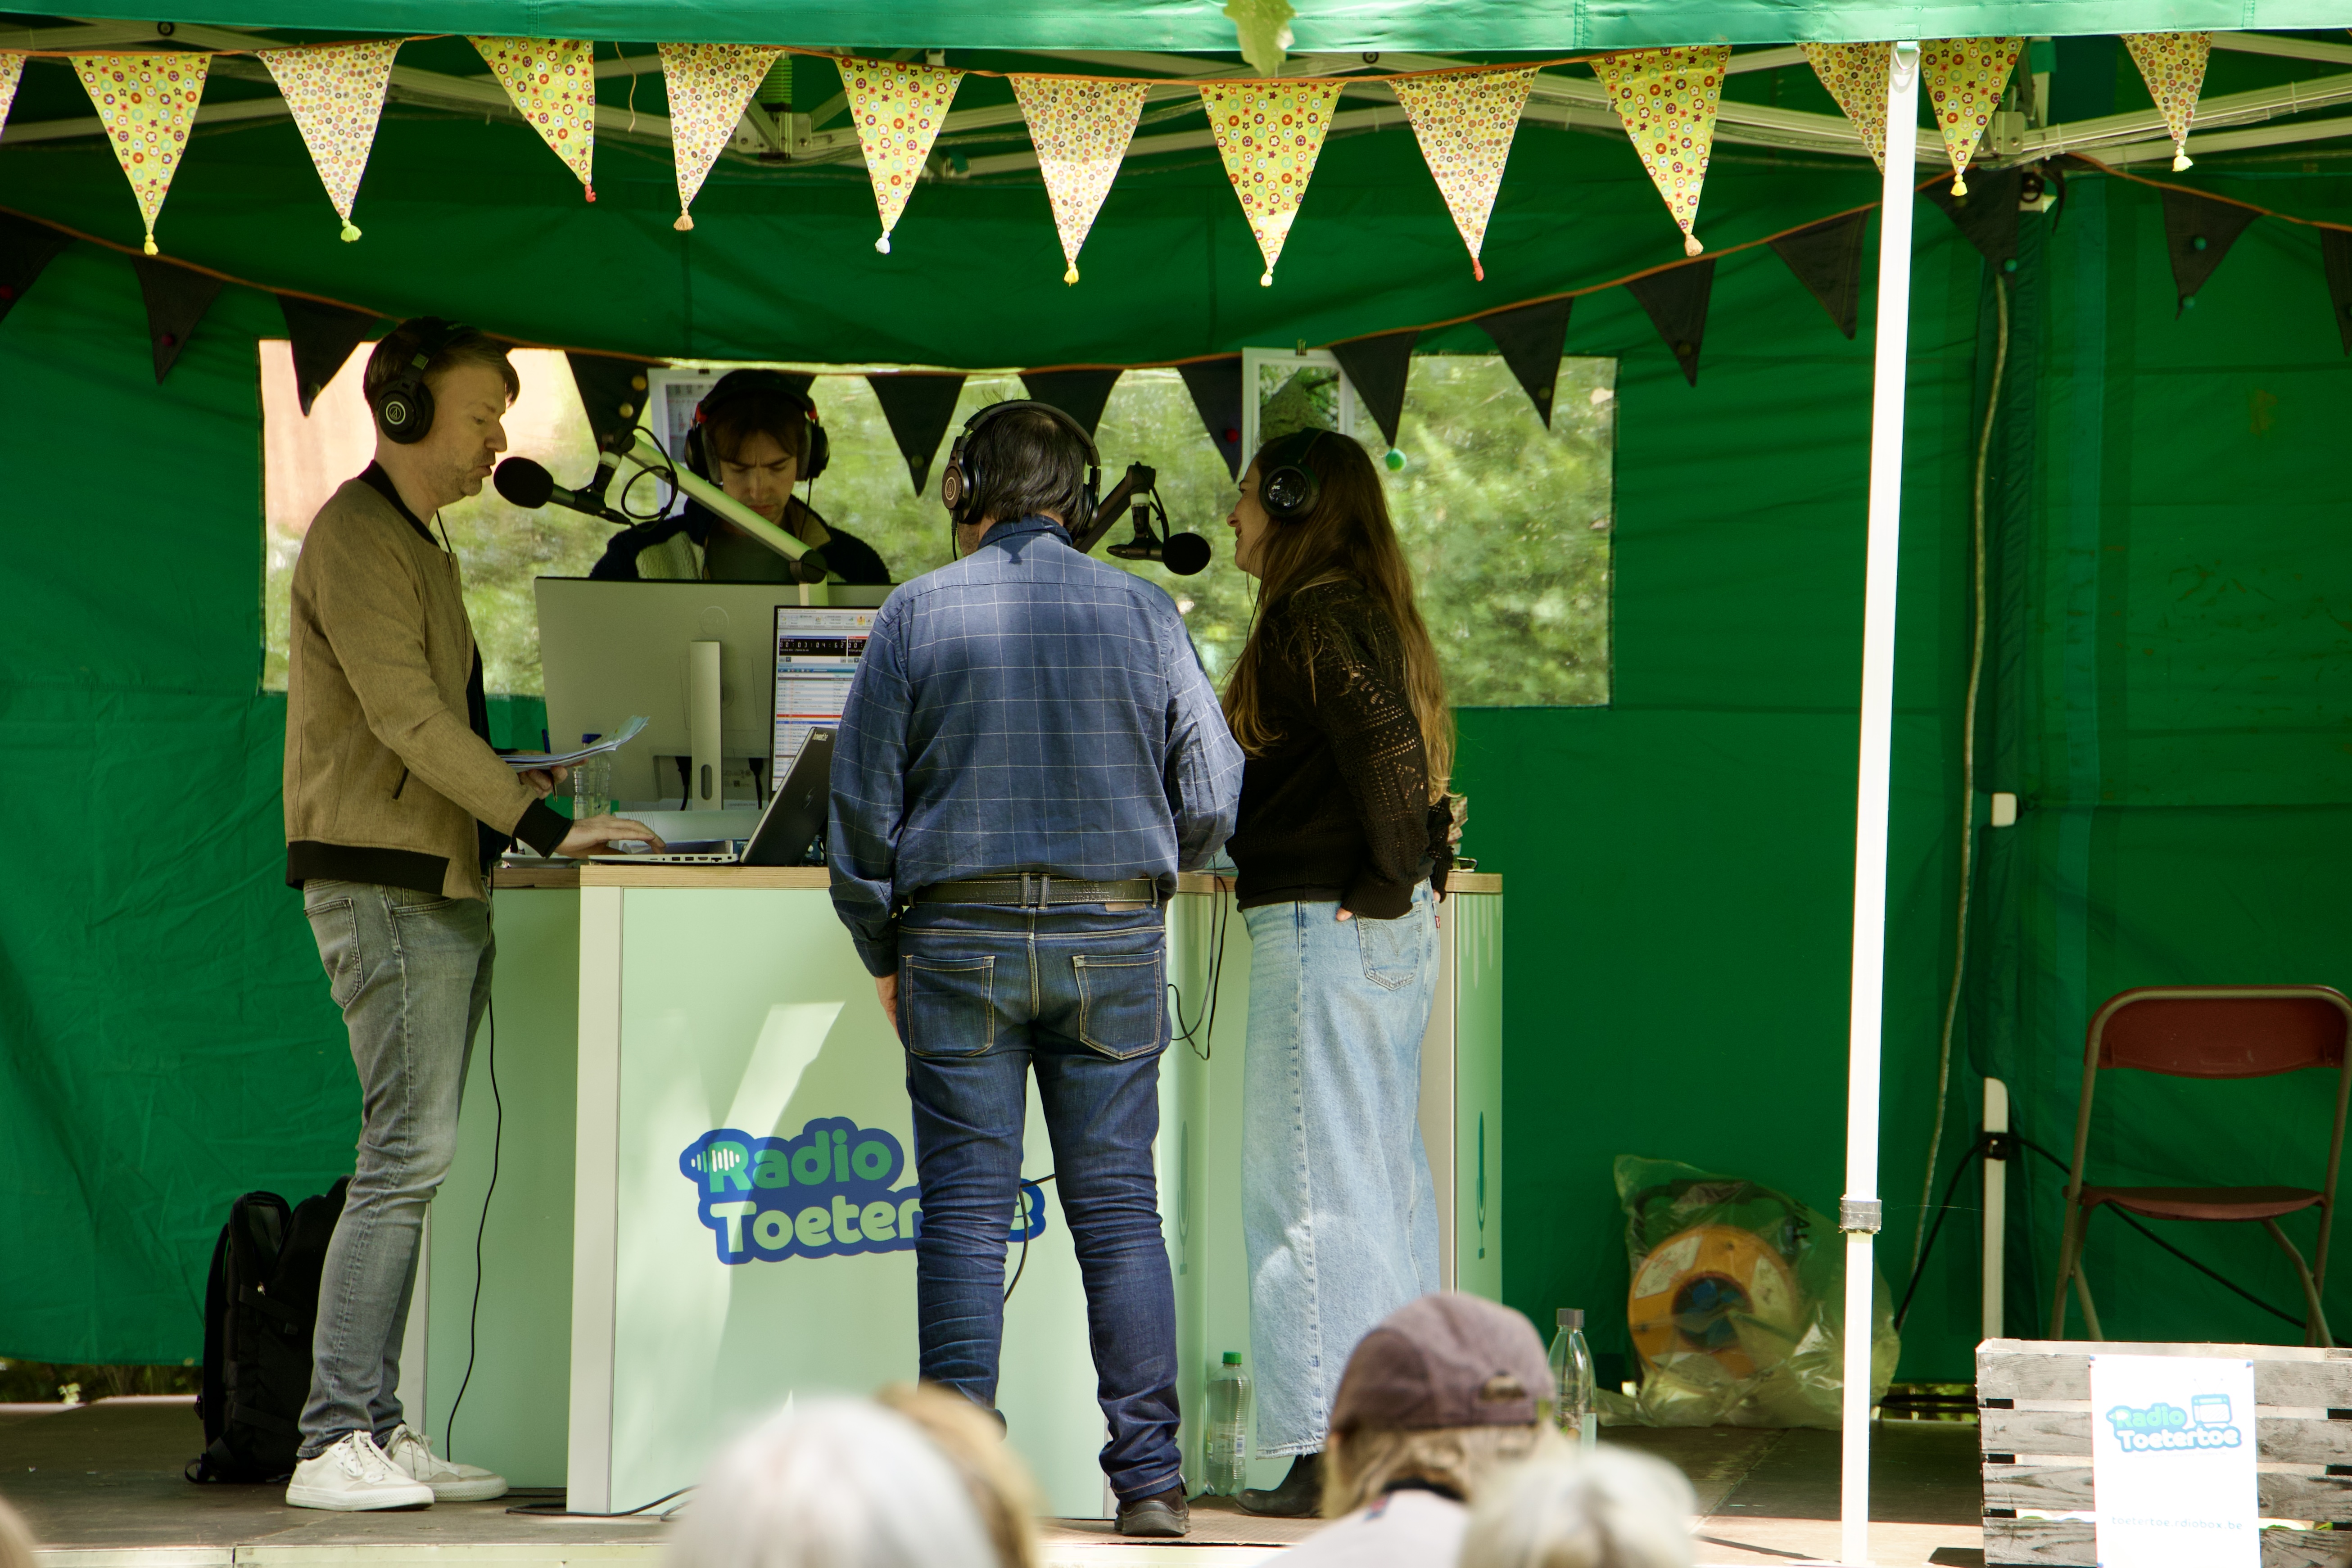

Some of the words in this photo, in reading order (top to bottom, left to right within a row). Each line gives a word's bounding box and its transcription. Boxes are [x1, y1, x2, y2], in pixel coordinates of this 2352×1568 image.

[708, 1129, 892, 1193] Radio
[2116, 1406, 2184, 1428] Radio
[2117, 1427, 2239, 1450] Toetertoe
